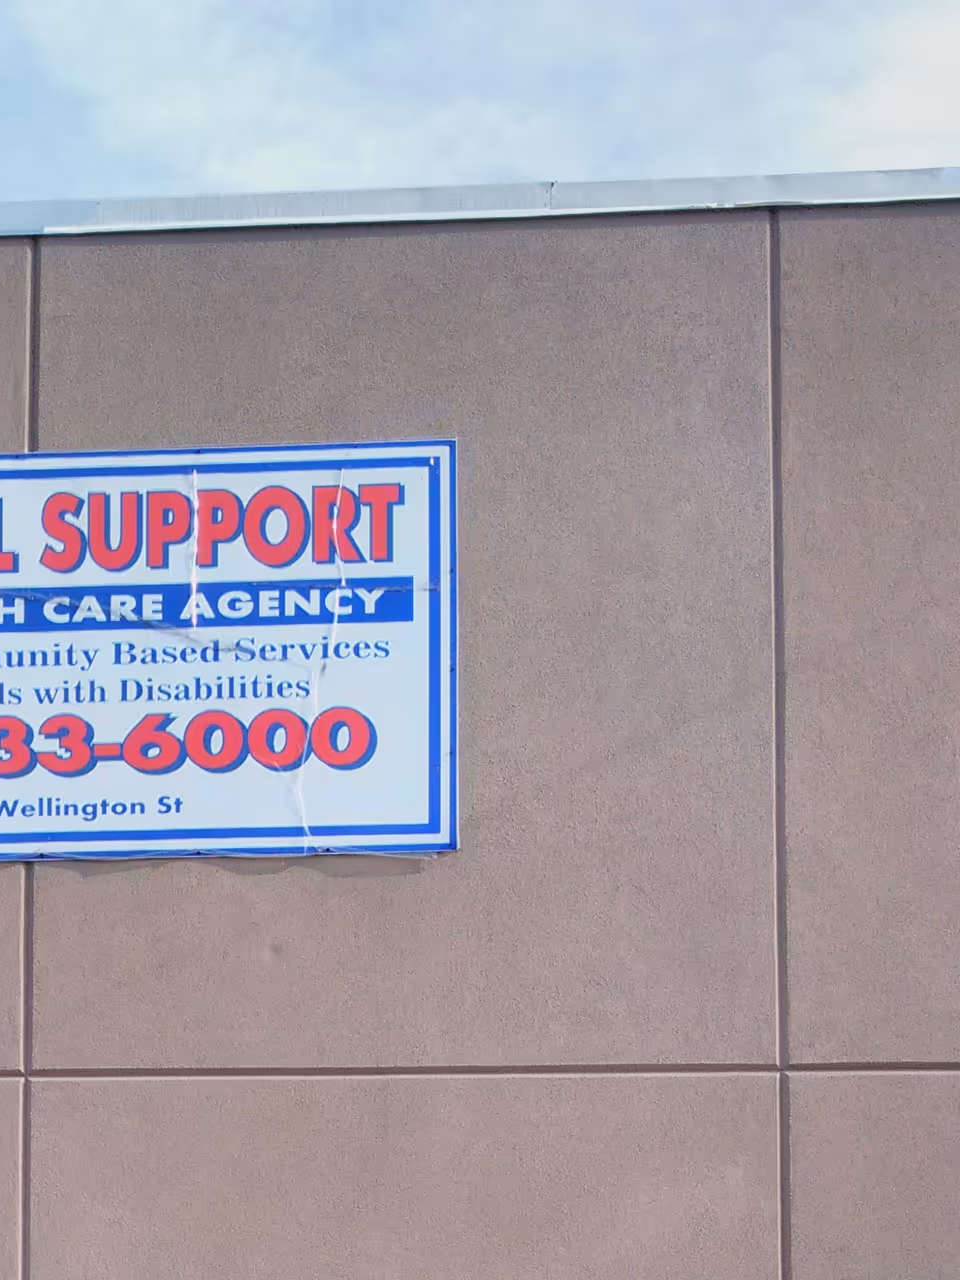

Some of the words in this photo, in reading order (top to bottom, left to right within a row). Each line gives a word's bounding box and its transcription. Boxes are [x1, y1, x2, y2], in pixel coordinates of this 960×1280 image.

[39, 483, 405, 573] SUPPORT
[42, 594, 163, 623] CARE
[180, 587, 386, 620] AGENCY
[110, 639, 229, 666] Based
[233, 636, 391, 664] Services
[32, 677, 106, 704] with
[119, 675, 311, 703] Disabilities
[157, 796, 184, 814] St
